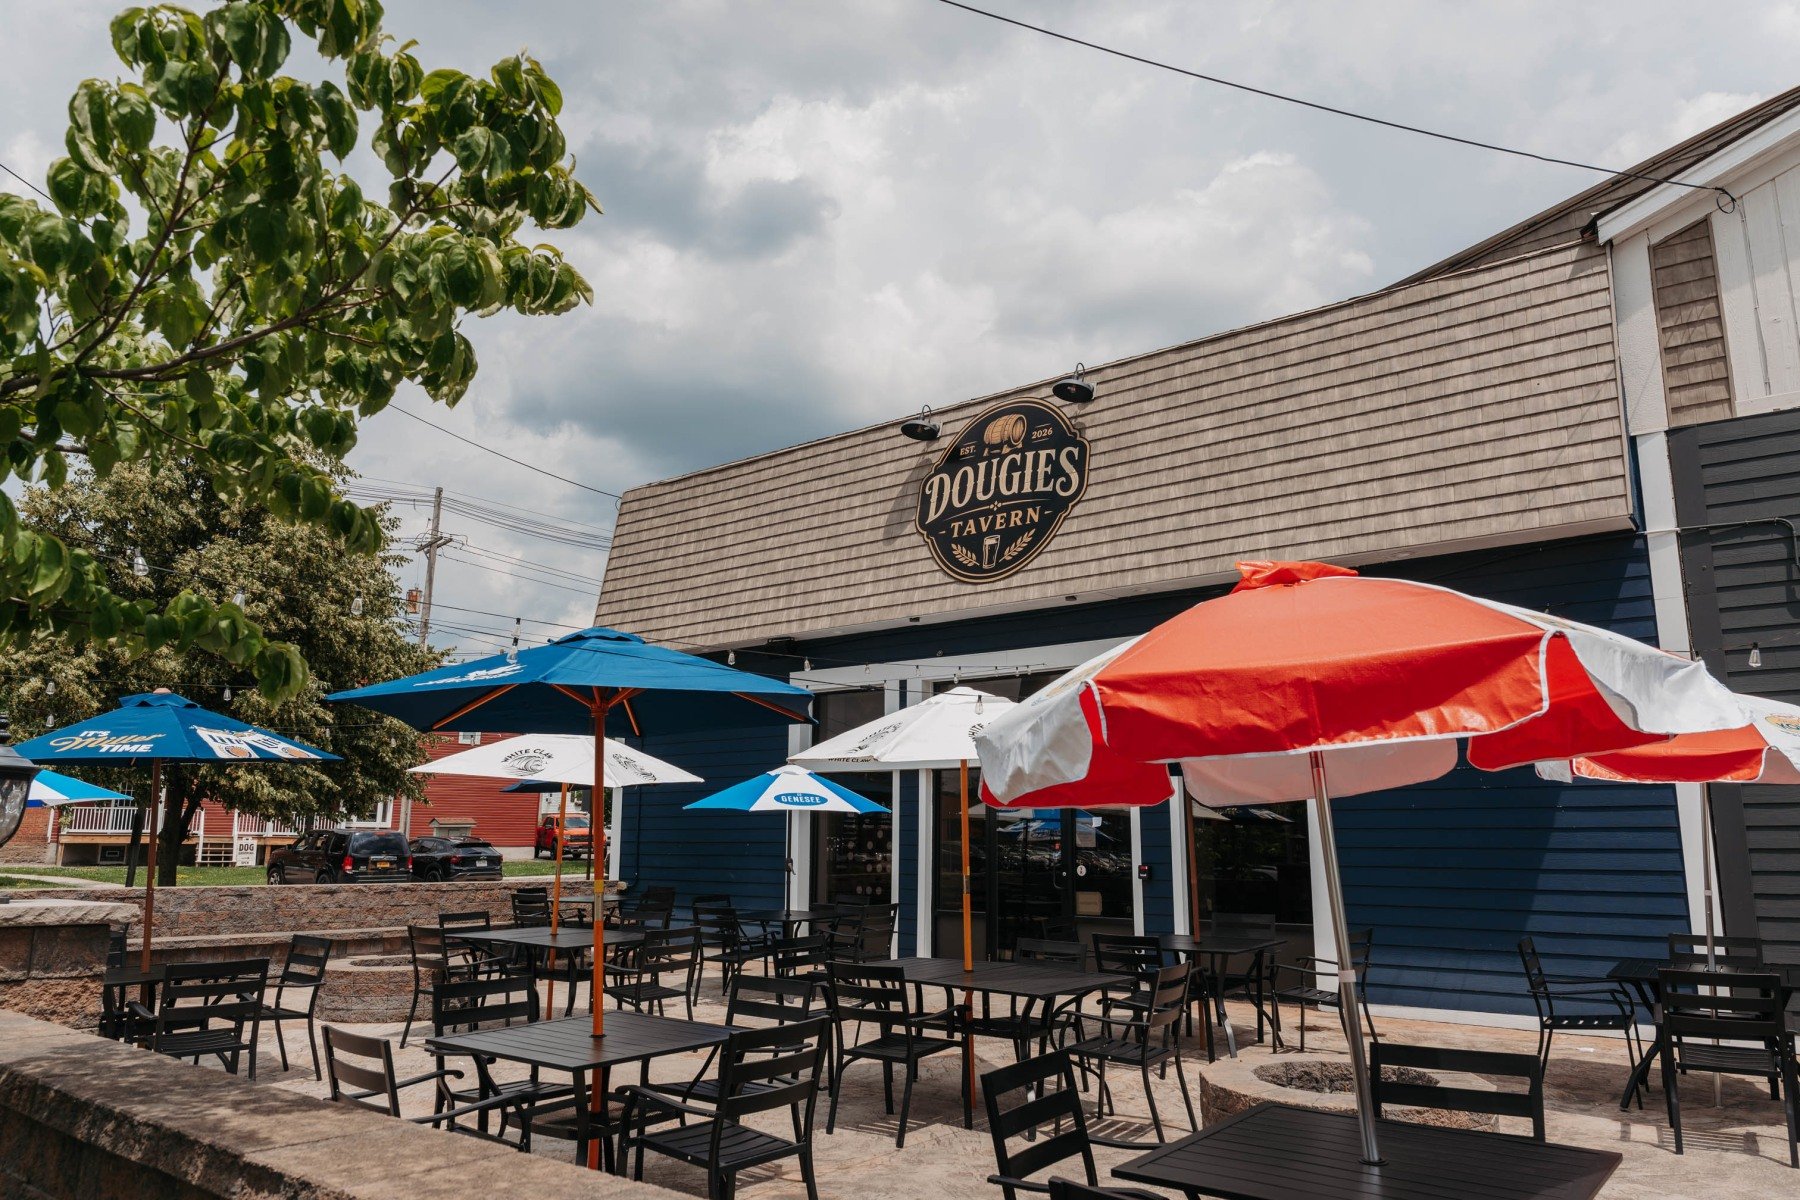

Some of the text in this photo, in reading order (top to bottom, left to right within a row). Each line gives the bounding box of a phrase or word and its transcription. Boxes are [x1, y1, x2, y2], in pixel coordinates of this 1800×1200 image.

[1031, 427, 1053, 439] 2026
[960, 445, 976, 456] EST.
[925, 447, 1079, 525] DOUGIES
[951, 506, 1041, 538] TAVERN
[501, 748, 554, 763] WHITE CLAW
[780, 795, 822, 803] GENESEE
[238, 843, 255, 852] DOG
